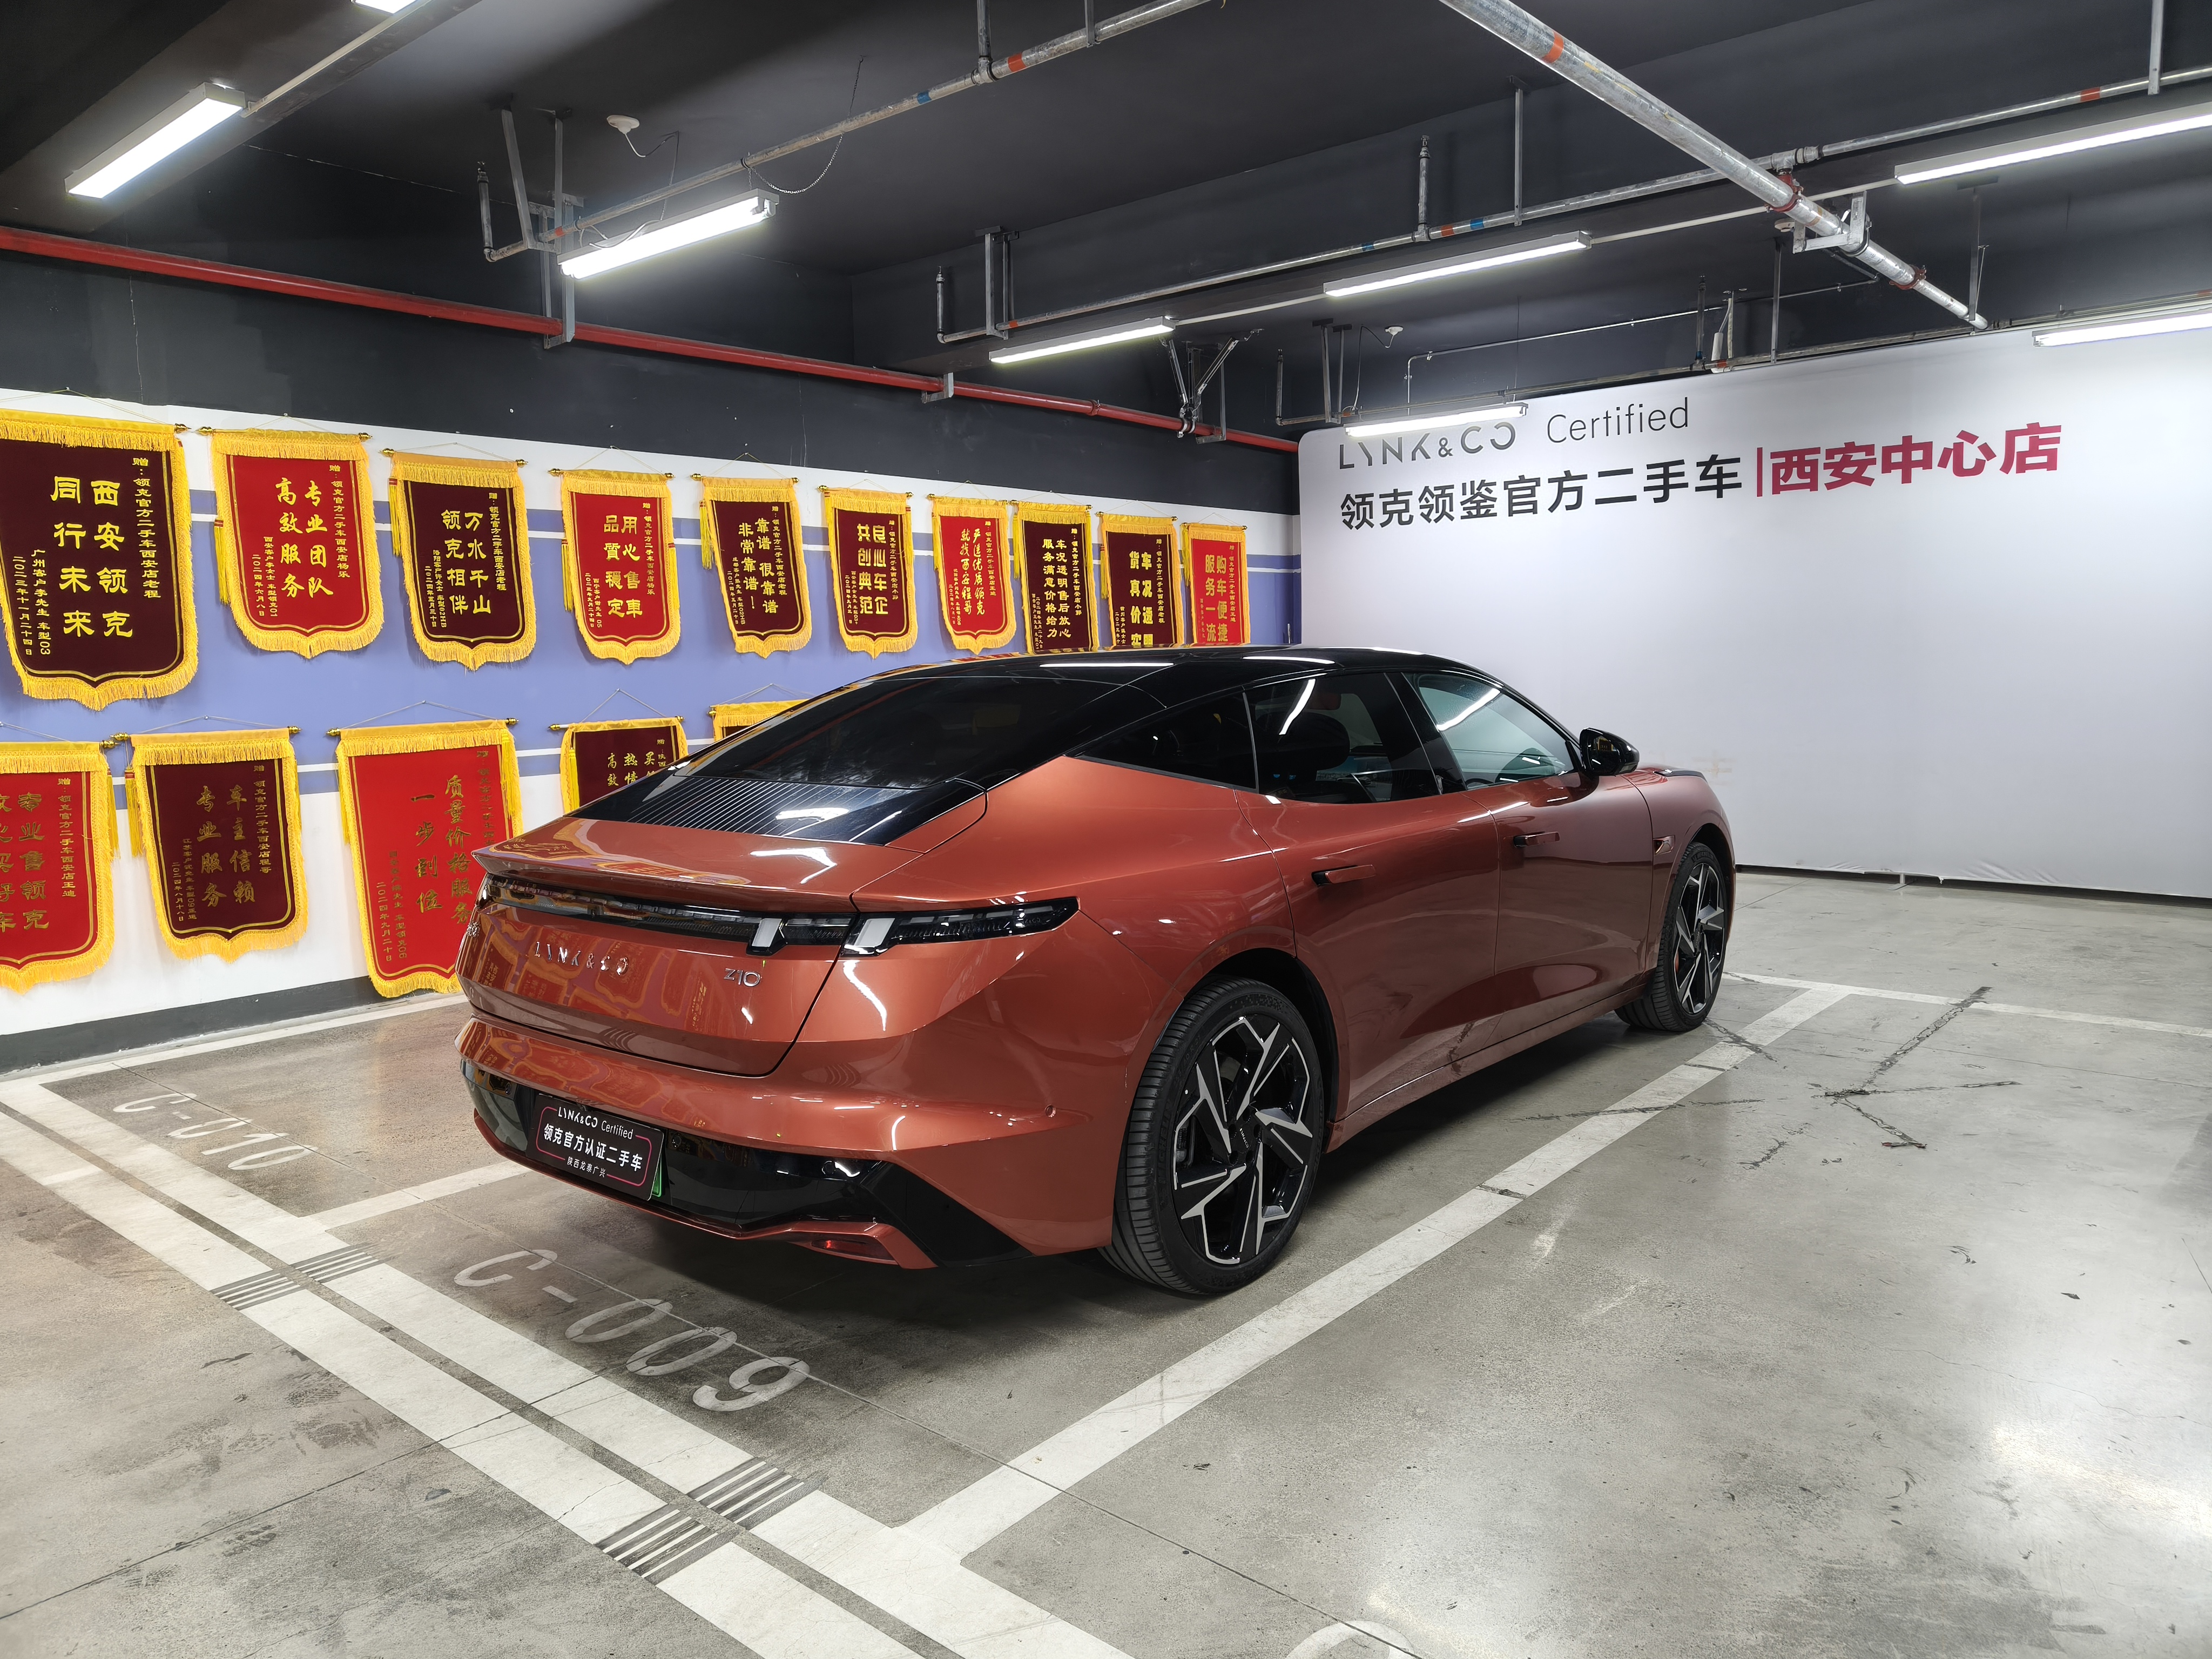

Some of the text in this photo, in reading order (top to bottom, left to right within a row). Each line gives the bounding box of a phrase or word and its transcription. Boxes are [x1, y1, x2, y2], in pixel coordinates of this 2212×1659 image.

[1547, 396, 1689, 444] Certified
[1340, 422, 2062, 530] 领克领鉴官方二手车 西安中心店
[50, 476, 95, 637] 同行未来
[91, 480, 133, 637] 西安领克
[264, 536, 275, 580] 西安客户李女士
[275, 477, 305, 598] 高效服务
[304, 480, 333, 598] 专业团队
[441, 509, 468, 615] 领克相伴
[464, 511, 491, 615] 万水千山
[603, 515, 625, 618] 品質穩定
[621, 517, 643, 618] 用心售車
[755, 518, 778, 614] 靠谱 很靠谱
[857, 523, 873, 614] 共创典范
[873, 525, 888, 615] 良心车企
[960, 528, 972, 615] 就找西安程哥
[972, 528, 985, 616] 严选优质领克
[31, 549, 51, 655] 广州客户李先生 车型03
[1042, 538, 1057, 638] 服务满意价格给力
[1056, 539, 1071, 638] 车况透明售后放心
[1205, 555, 1217, 642] 服务一流
[1217, 555, 1228, 642] 购车便捷
[606, 752, 619, 787] 高效
[624, 753, 637, 785] 热情
[197, 786, 227, 907] 专业服务
[226, 785, 255, 903] 车主信赖
[411, 793, 443, 913] 一步到位
[444, 774, 473, 925] 质量价格服务
[534, 941, 630, 976] LYNK&CO
[724, 968, 763, 987] Z10
[113, 1092, 319, 1170] C-010
[544, 1123, 643, 1171] 领克官方认证二手车
[558, 1107, 633, 1139] LYNK&CO Certified
[454, 1249, 810, 1412] C-009
